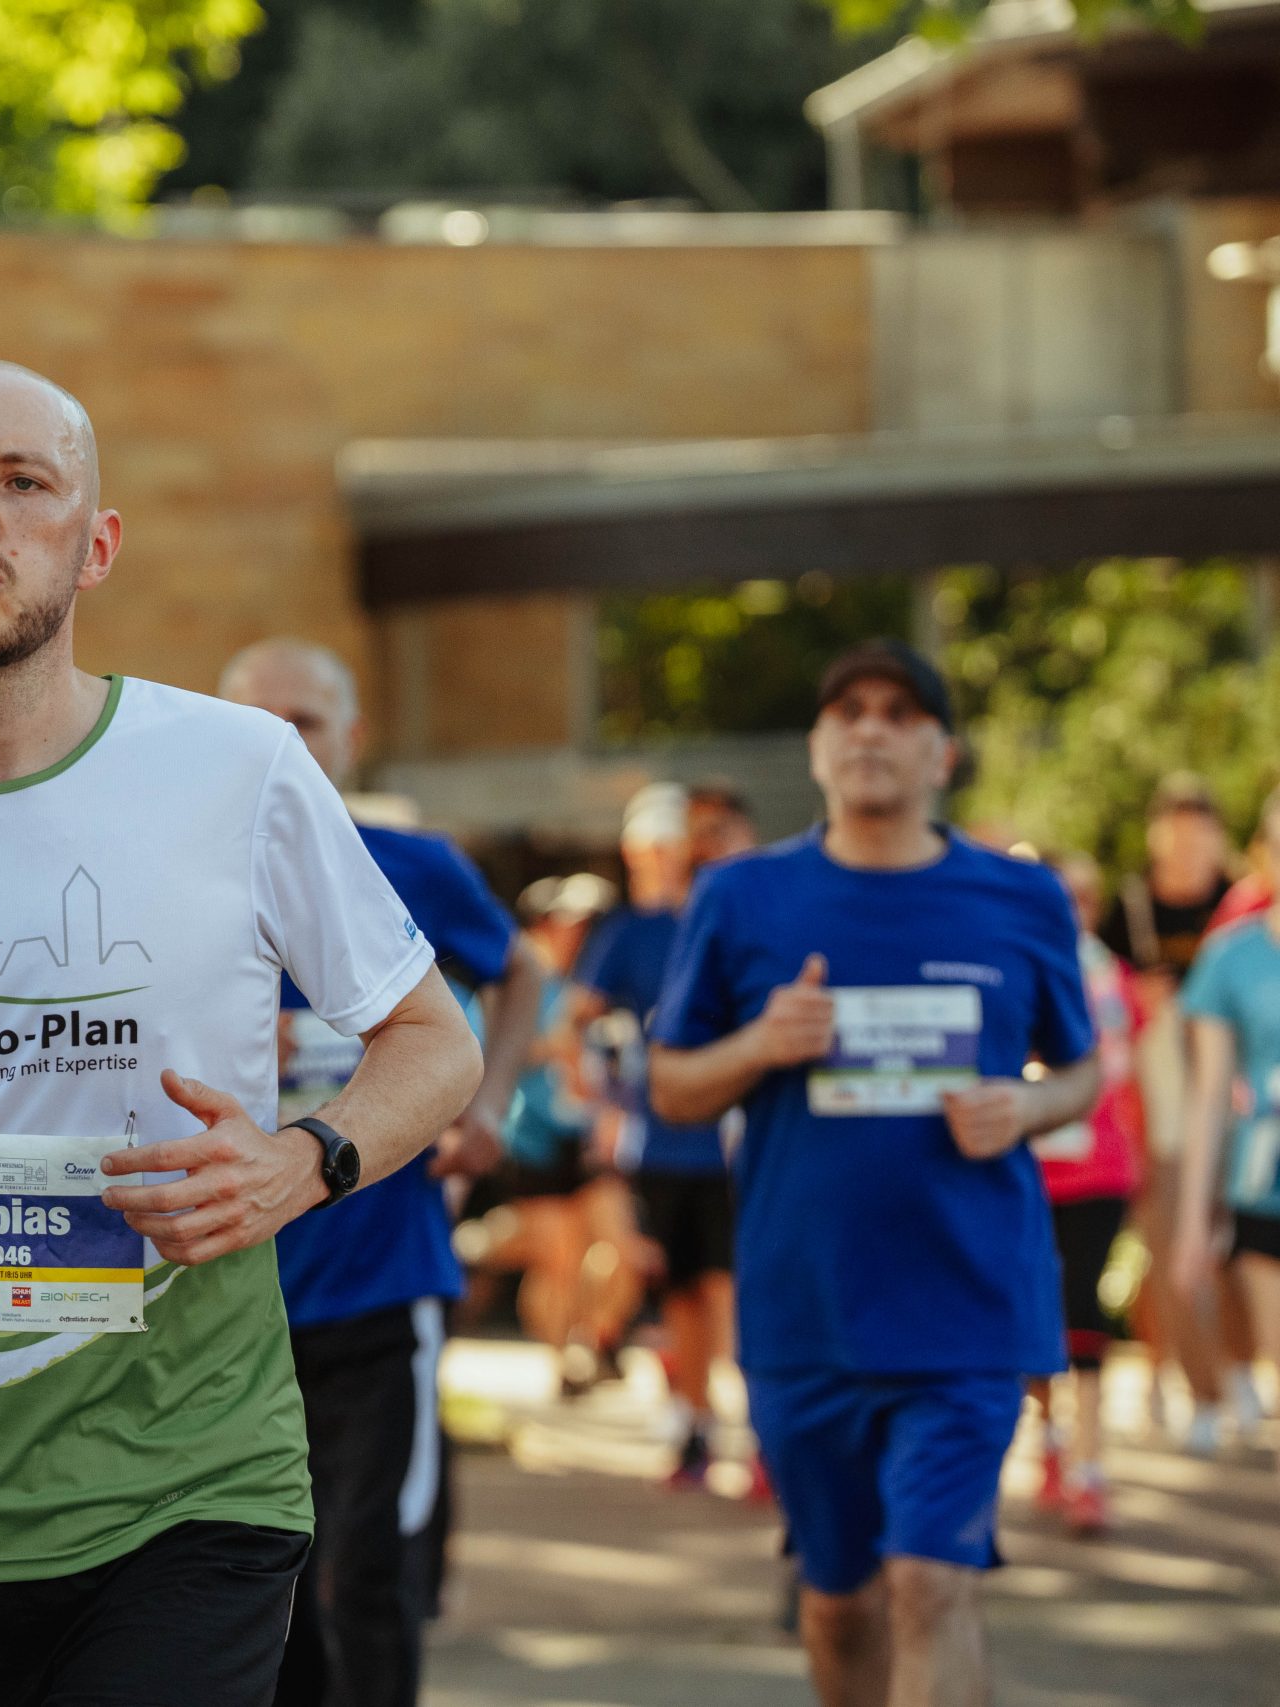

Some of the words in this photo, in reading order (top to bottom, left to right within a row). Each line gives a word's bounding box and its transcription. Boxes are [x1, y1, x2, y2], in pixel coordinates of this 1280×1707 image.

[21, 1057, 50, 1075] mit
[56, 1053, 138, 1078] Expertise
[20, 1271, 33, 1279] UHR
[40, 1292, 110, 1302] BIONTECH
